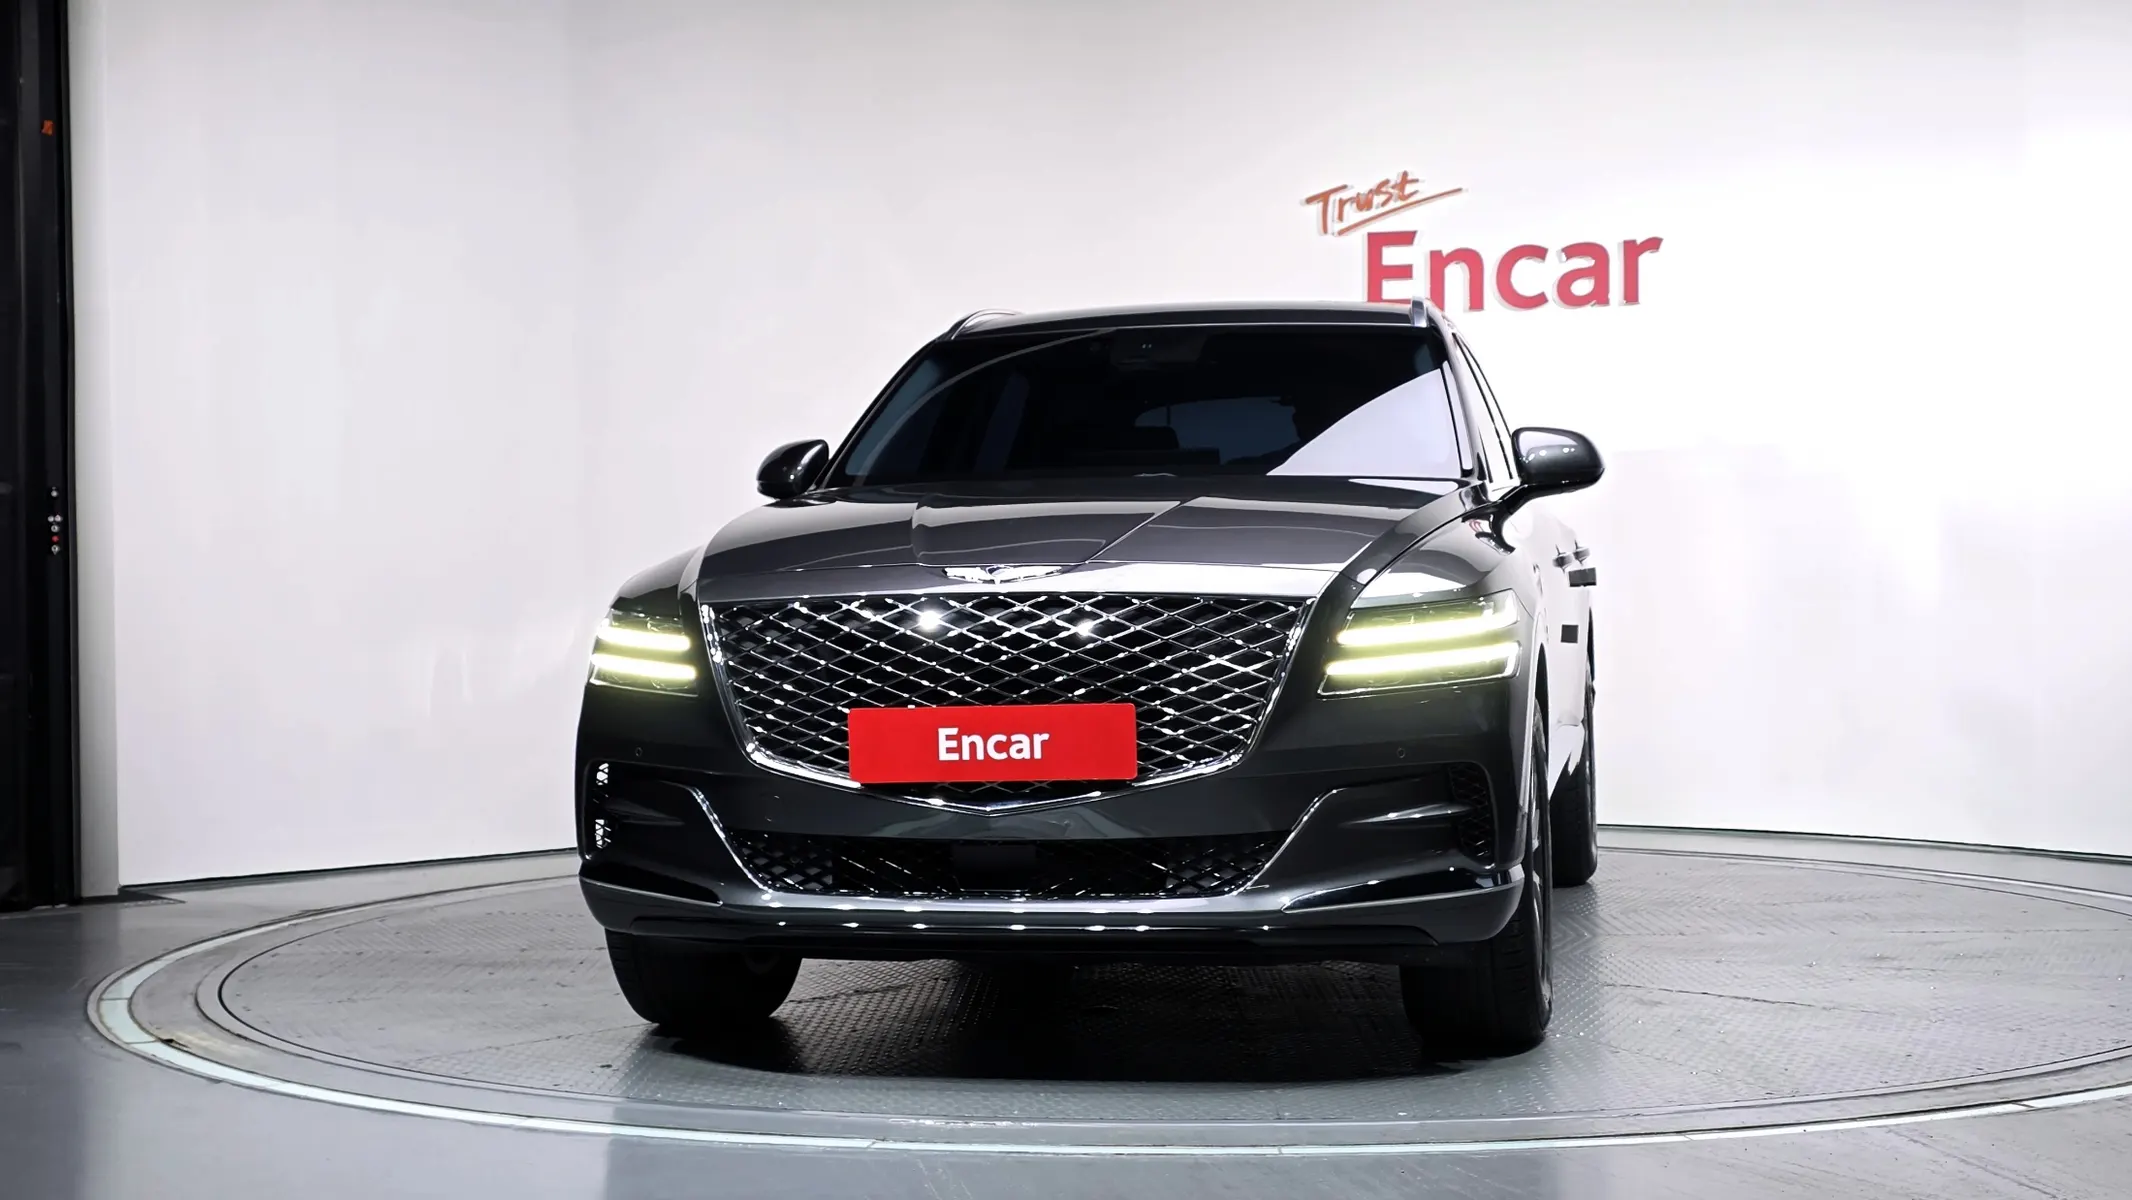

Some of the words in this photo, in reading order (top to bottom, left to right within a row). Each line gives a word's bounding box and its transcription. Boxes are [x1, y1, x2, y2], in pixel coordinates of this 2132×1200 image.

[1305, 170, 1420, 234] Trust
[1366, 230, 1664, 312] Encar
[937, 727, 1050, 761] Encar
